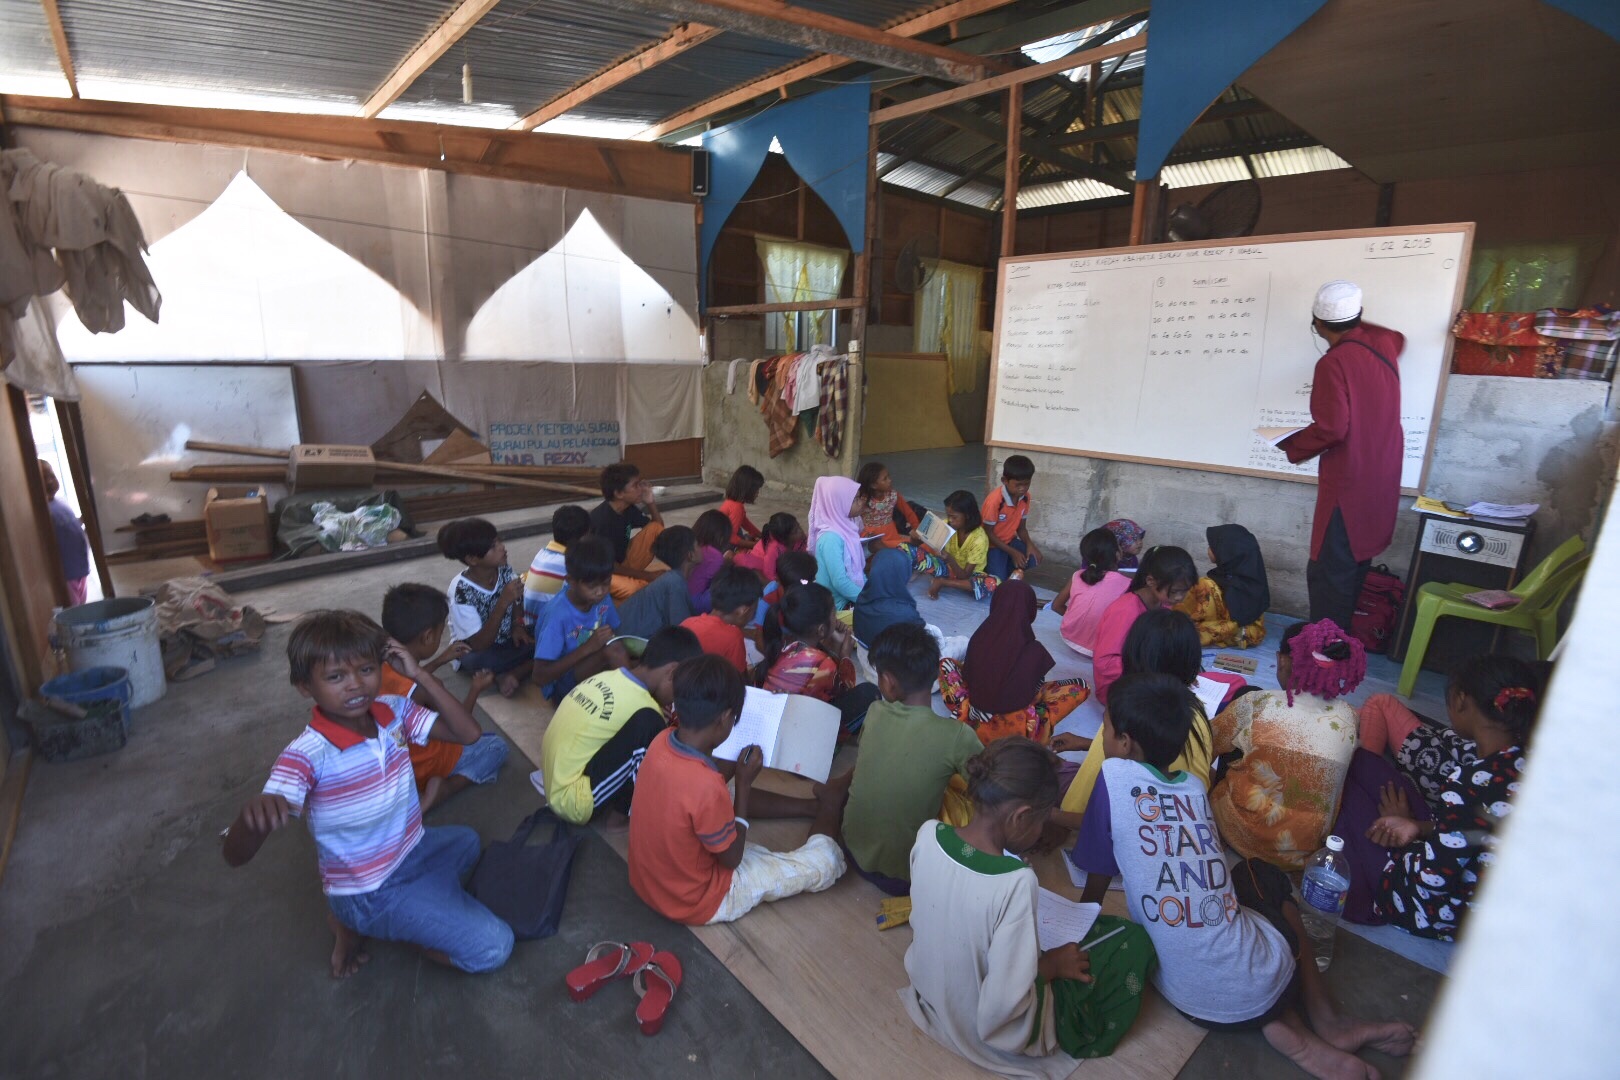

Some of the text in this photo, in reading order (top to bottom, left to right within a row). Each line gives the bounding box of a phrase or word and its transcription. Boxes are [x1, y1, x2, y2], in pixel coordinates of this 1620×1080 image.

[490, 423, 533, 436] PROJEK
[588, 421, 620, 434] SURAU
[1156, 858, 1228, 893] AND
